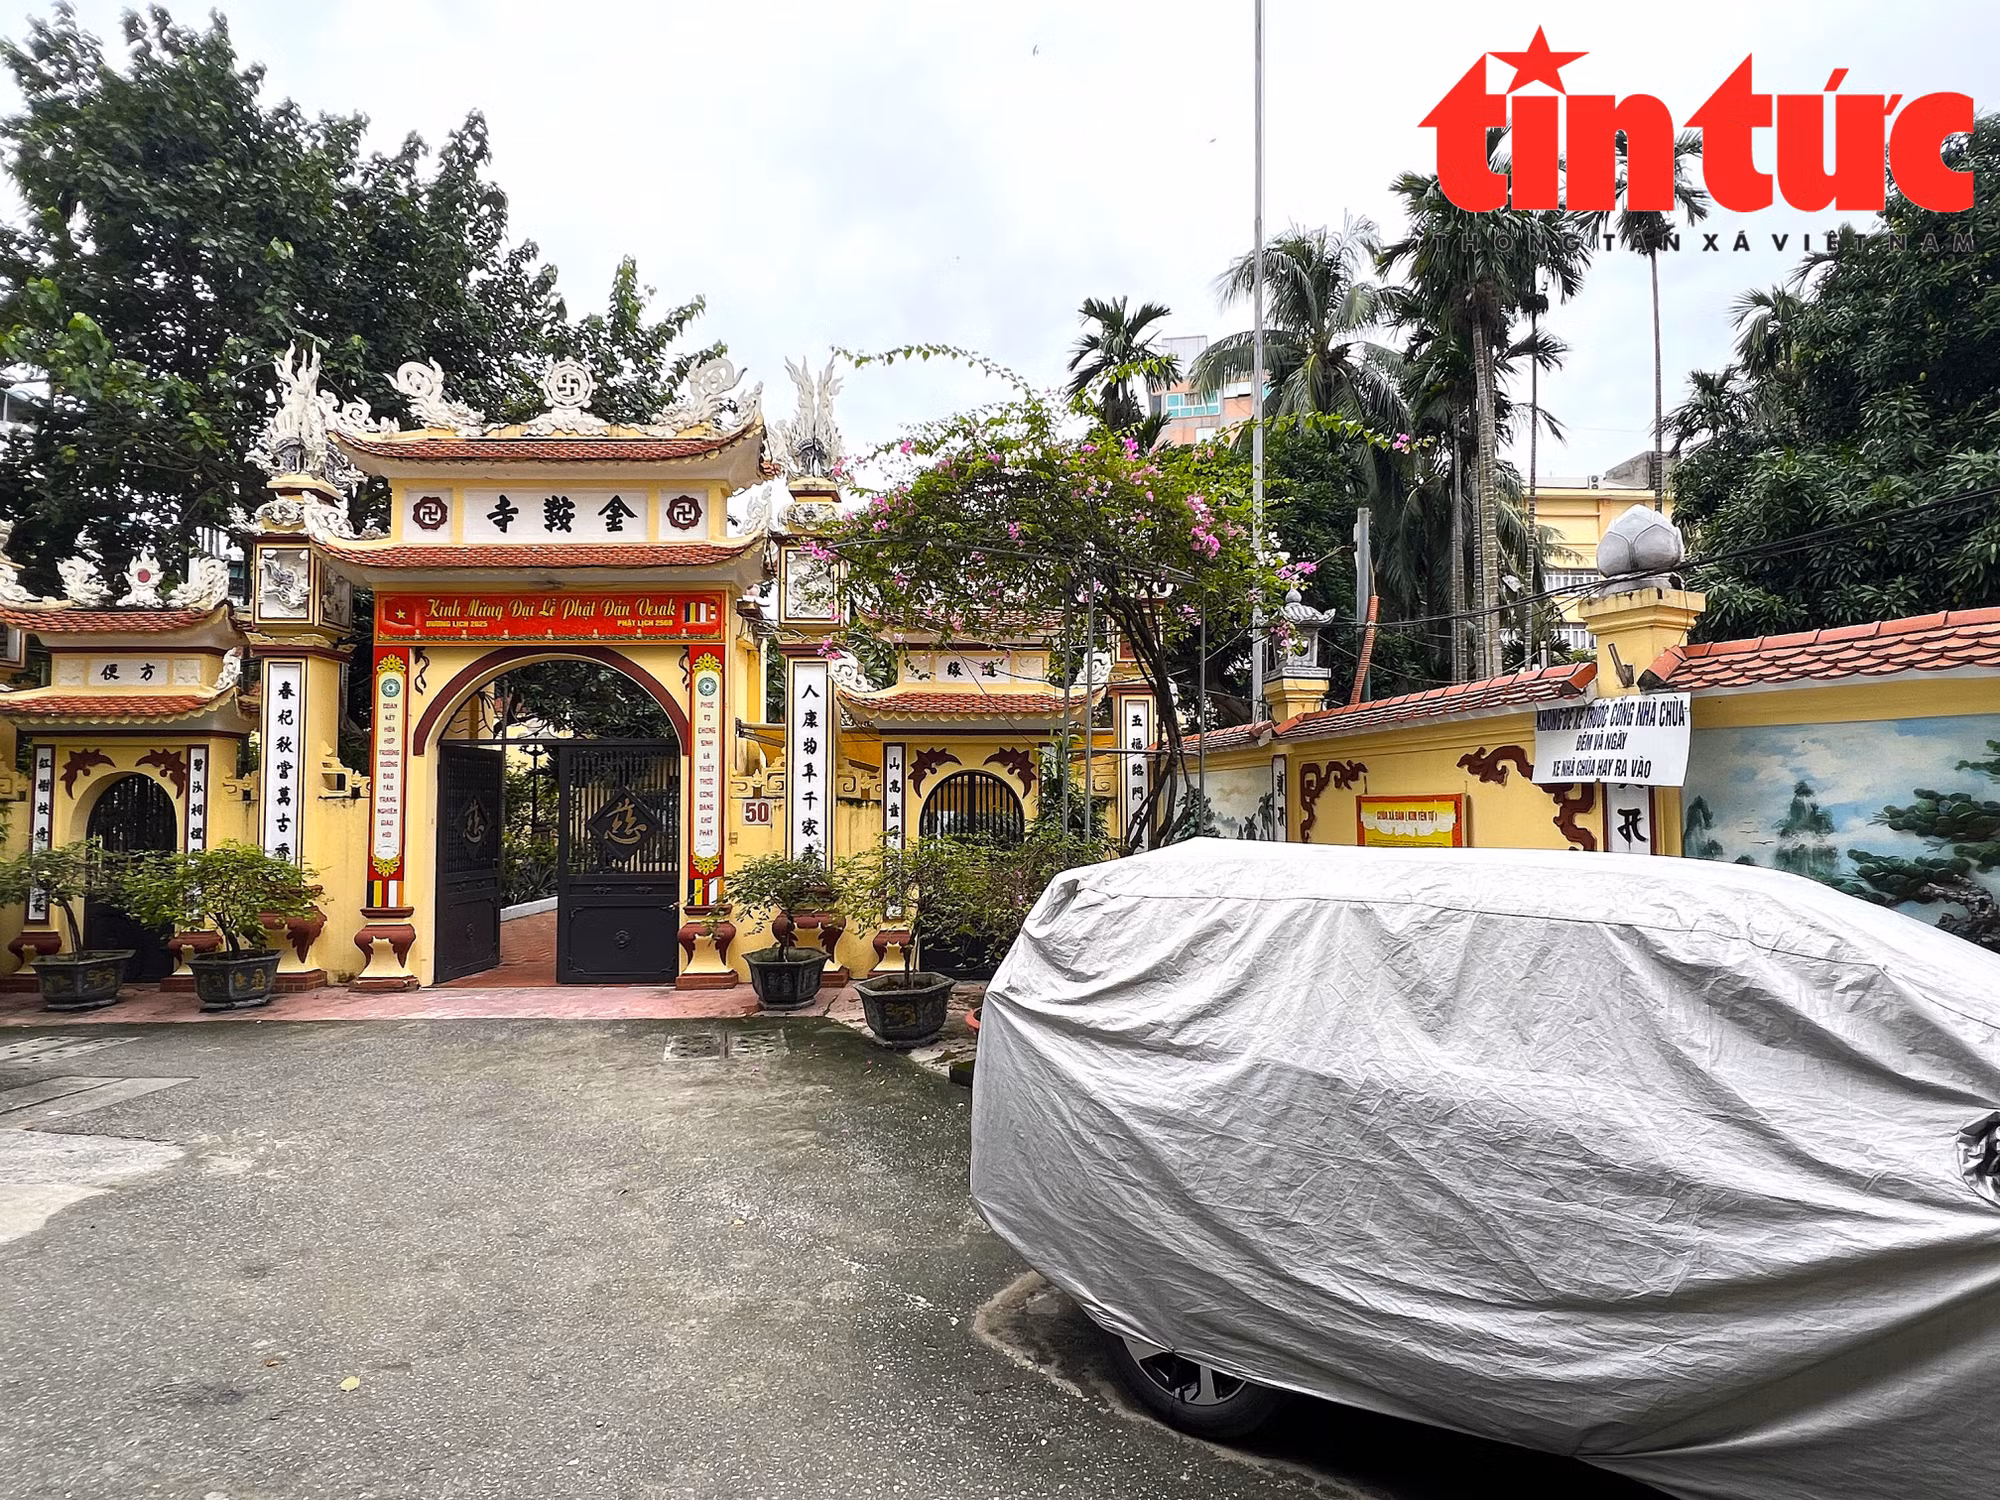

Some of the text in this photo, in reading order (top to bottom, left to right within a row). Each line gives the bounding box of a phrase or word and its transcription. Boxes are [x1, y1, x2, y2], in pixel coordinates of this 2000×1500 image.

[508, 600, 536, 620] Đại
[560, 598, 596, 620] Phật
[635, 598, 676, 617] Vesak
[1635, 697, 1657, 726] NHÀ
[1659, 696, 1685, 726] CHÙA
[1596, 759, 1614, 776] HAY
[1614, 759, 1627, 777] RA
[1631, 755, 1652, 778] VÀO
[745, 802, 769, 822] 50
